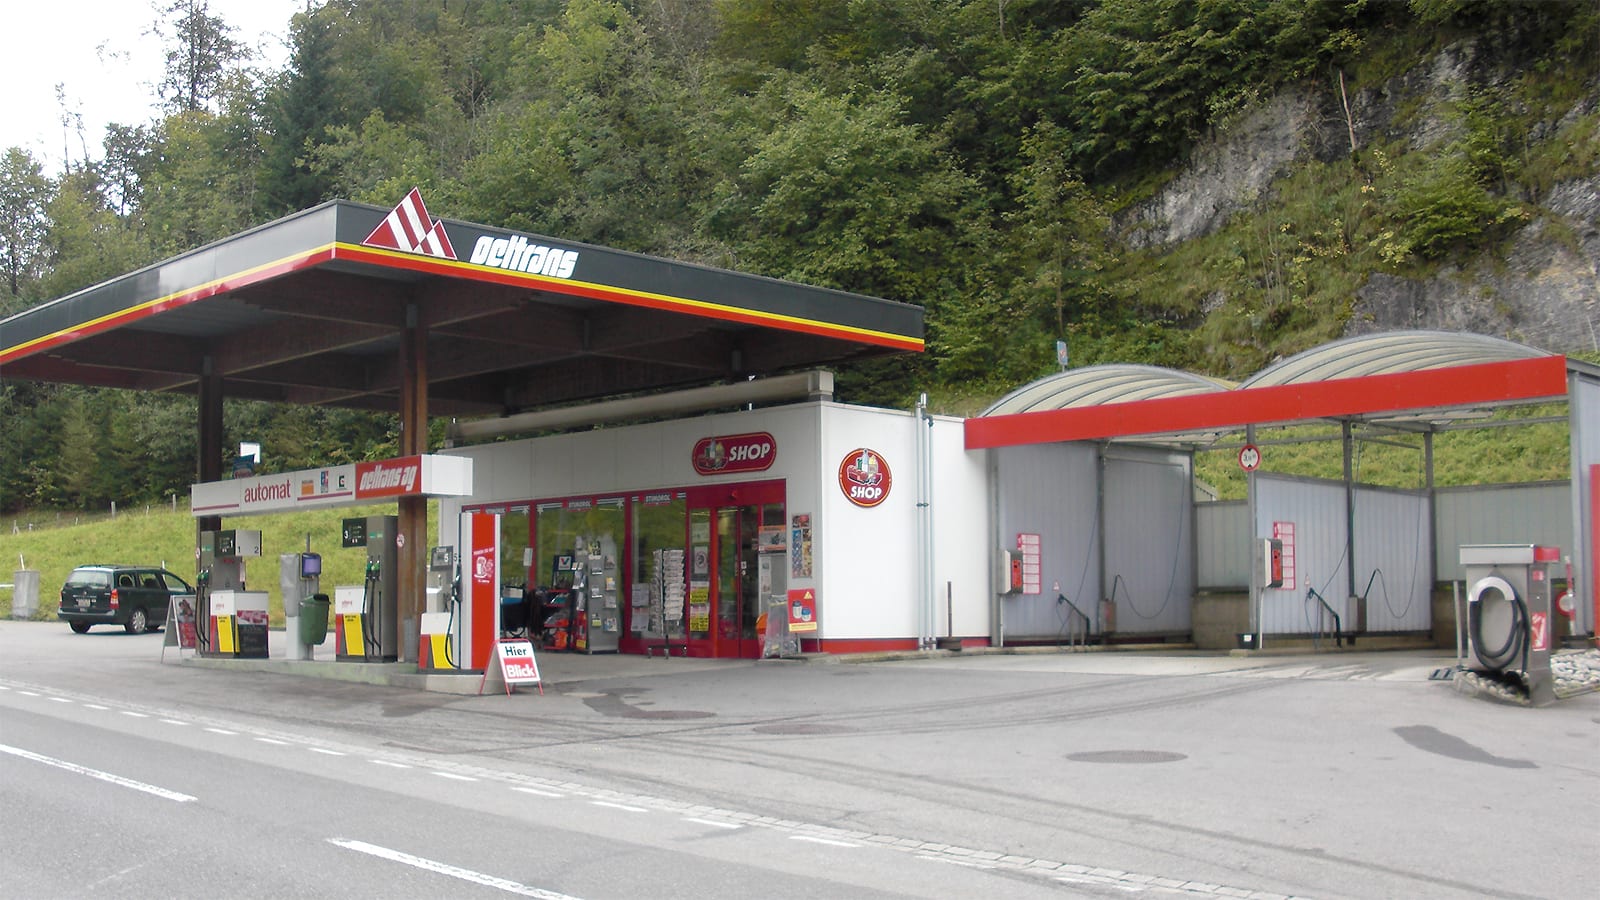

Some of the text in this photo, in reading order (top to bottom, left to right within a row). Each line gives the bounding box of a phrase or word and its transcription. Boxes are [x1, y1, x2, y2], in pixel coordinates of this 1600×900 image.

[470, 234, 579, 278] oeltrans
[729, 443, 771, 461] SHOP
[359, 464, 417, 491] oeltrans ag
[244, 479, 291, 503] automat
[850, 485, 882, 499] SHOP
[343, 530, 349, 539] 3
[254, 546, 260, 554] 2
[504, 646, 527, 657] Hier
[505, 664, 535, 678] Blick
